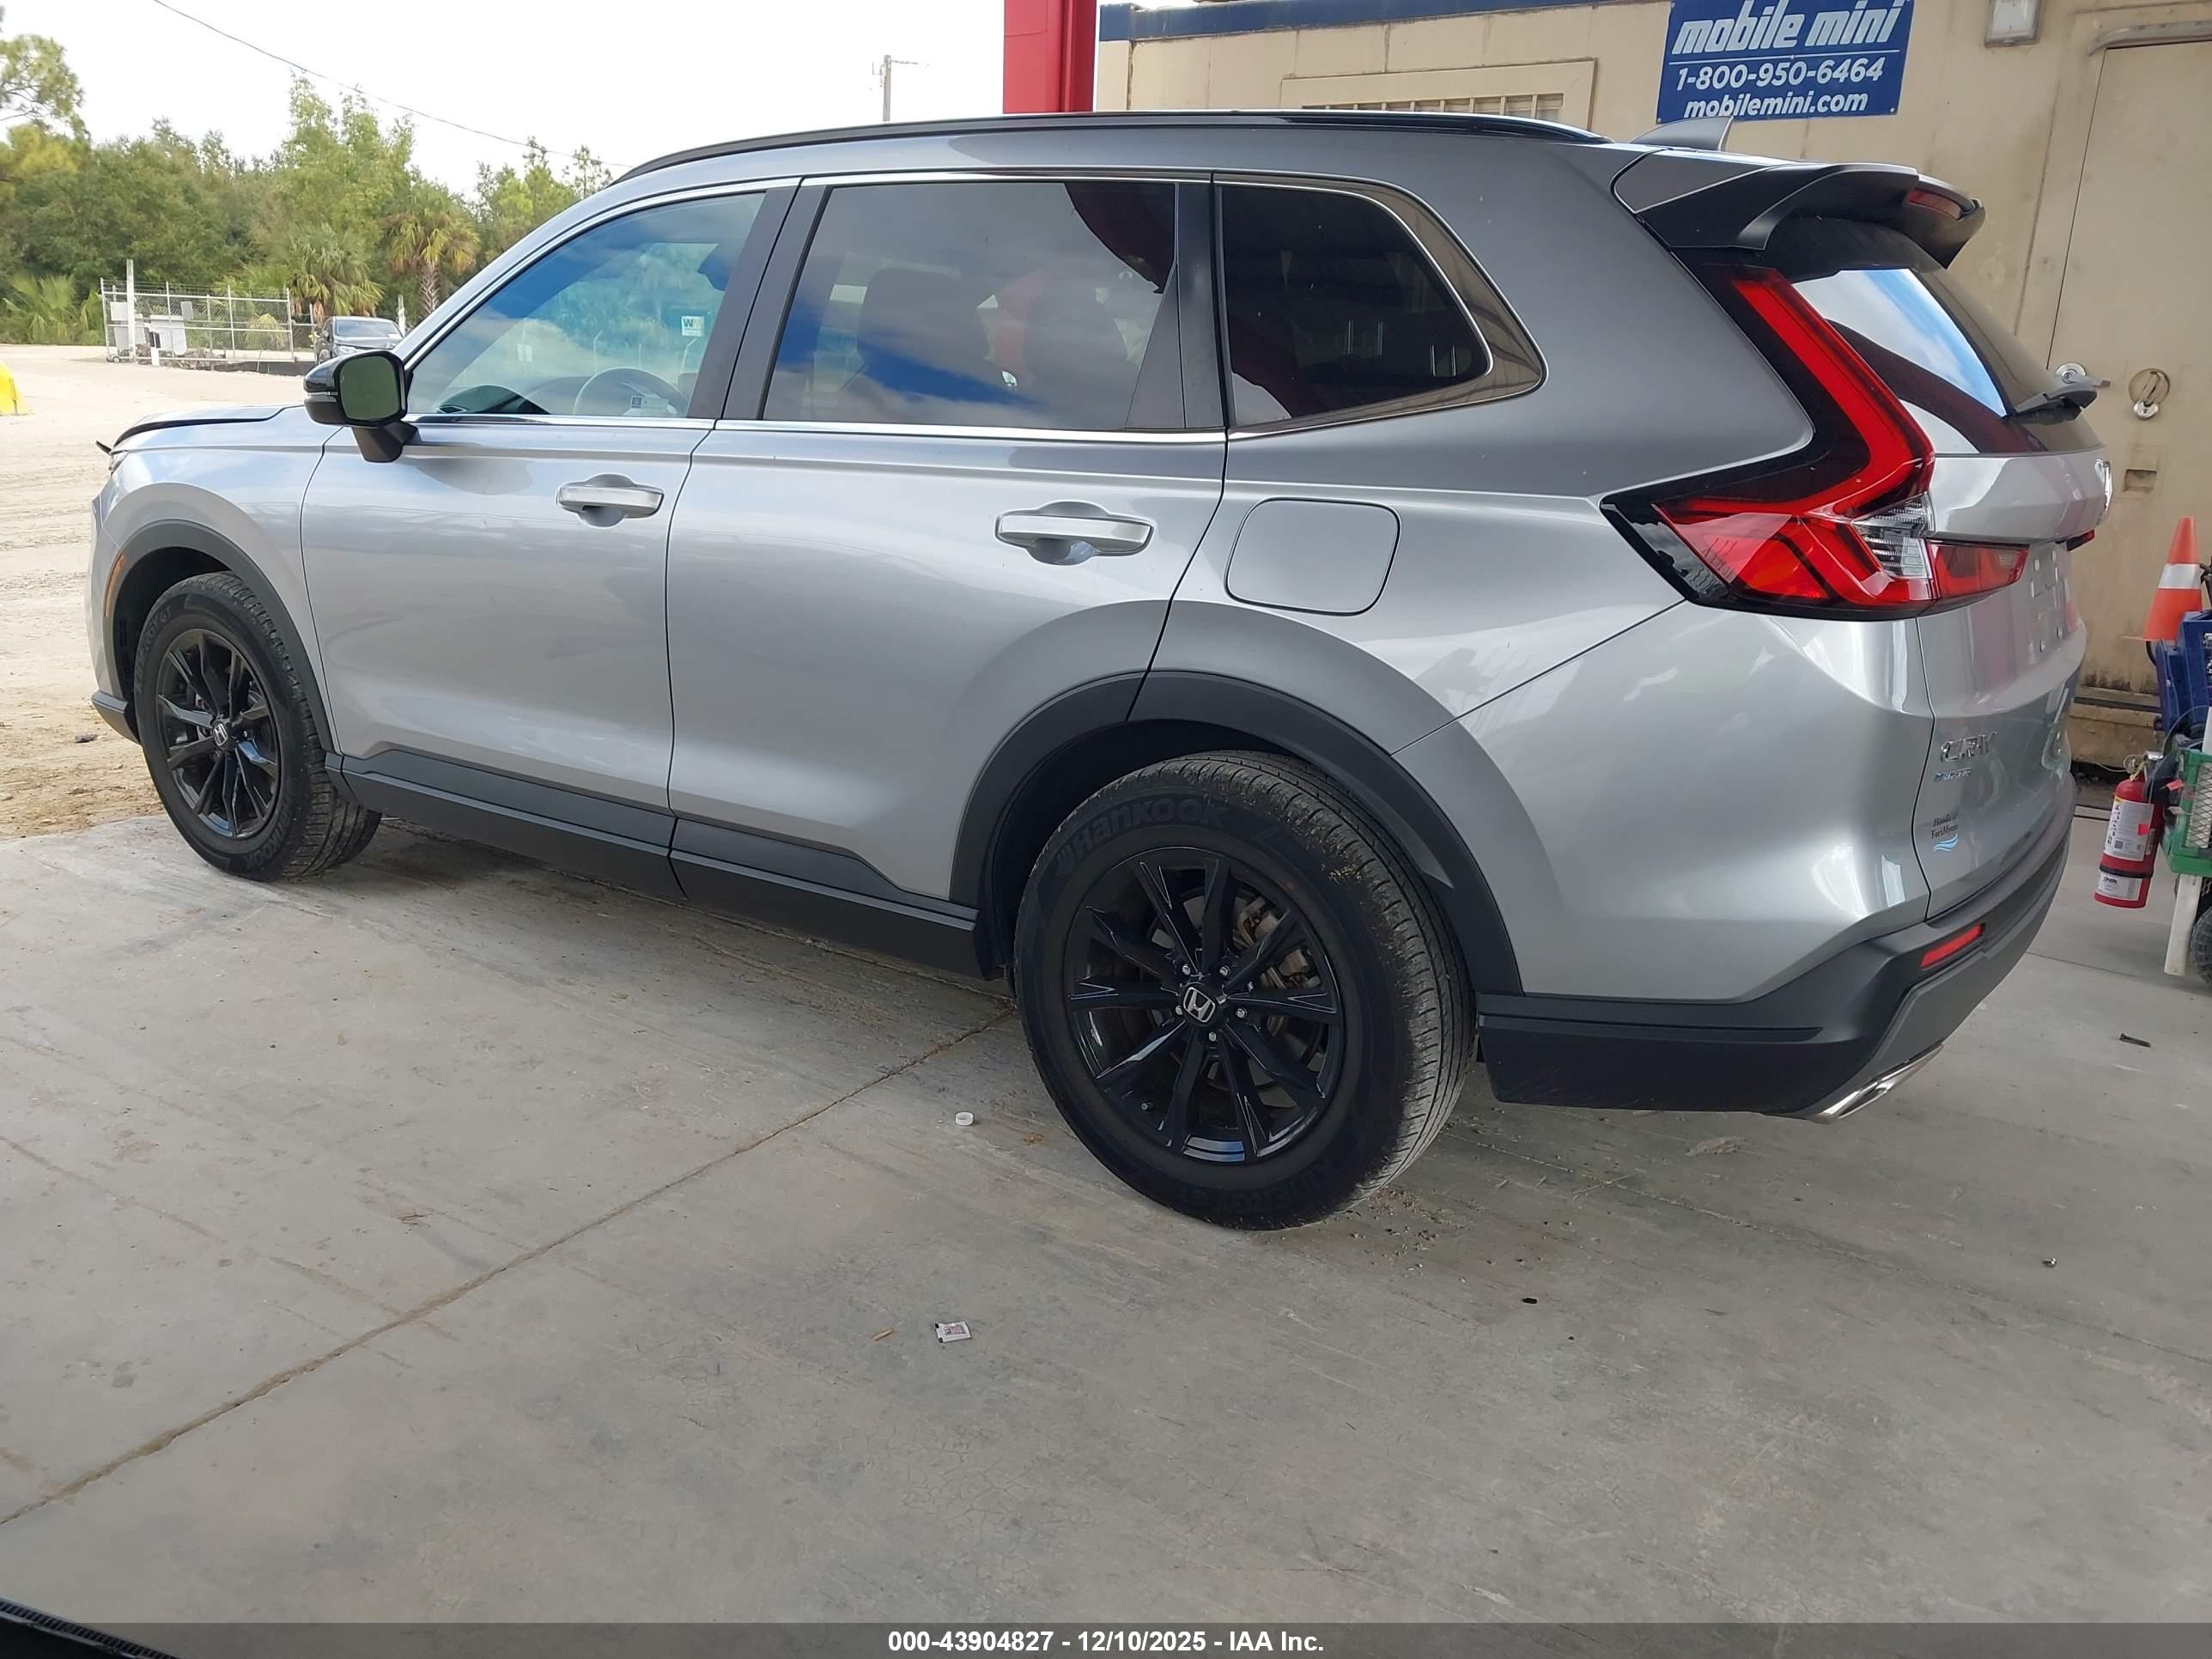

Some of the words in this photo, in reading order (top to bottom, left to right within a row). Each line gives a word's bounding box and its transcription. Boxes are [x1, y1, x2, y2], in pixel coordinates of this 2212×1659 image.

[1671, 0, 1805, 55] mobile
[1804, 0, 1903, 47] mini
[1676, 58, 1884, 91] 1-800-950-6464
[1684, 90, 1869, 118] mobilemini.com
[1074, 797, 1230, 854] Hankook
